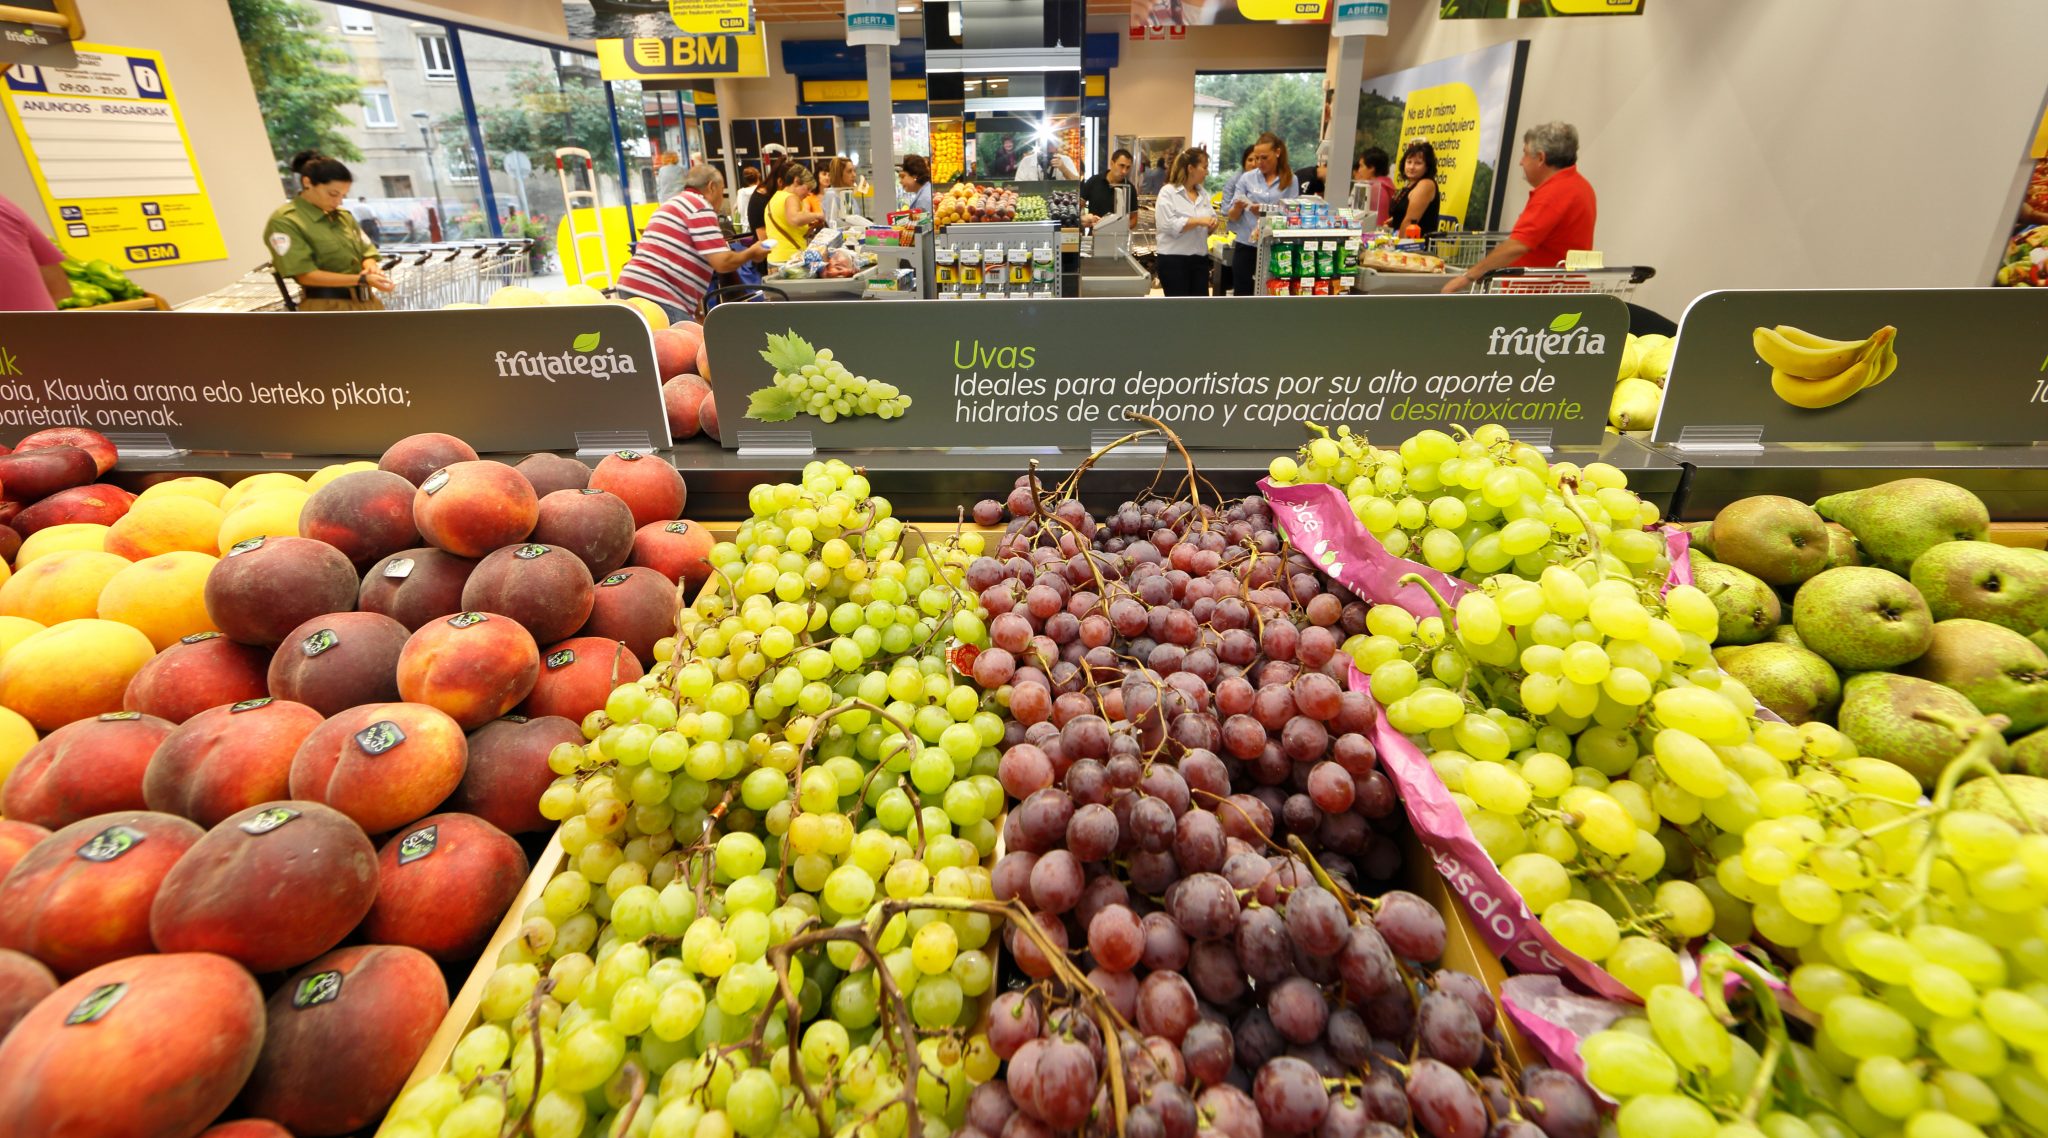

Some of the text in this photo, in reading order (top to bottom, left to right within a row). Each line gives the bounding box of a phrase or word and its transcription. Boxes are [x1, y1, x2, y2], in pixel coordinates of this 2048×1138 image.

[853, 16, 887, 25] ABIERTA
[1347, 7, 1384, 16] ABIERTA
[672, 35, 727, 66] BM
[59, 82, 91, 94] 09:00
[22, 100, 92, 114] ANUNCIOS
[101, 104, 169, 117] IRAGARKIAK
[1407, 102, 1457, 121] No es lo mismo
[1404, 118, 1476, 137] una carne cualquiera
[147, 245, 176, 260] BM
[953, 339, 1036, 370] Uvas
[1486, 326, 1607, 363] fruteria
[494, 347, 638, 383] frutategia
[43, 378, 129, 401] Klaudia
[133, 383, 198, 402] arana
[202, 380, 243, 403] edo
[248, 380, 326, 405] Jerteko
[331, 381, 411, 410] pikota;
[953, 367, 1557, 402] Ideales para deportistas por su alto aporte de
[96, 404, 184, 427] onenak.
[955, 396, 1586, 428] hidratos de carbono y capacidad desintoxicante.
